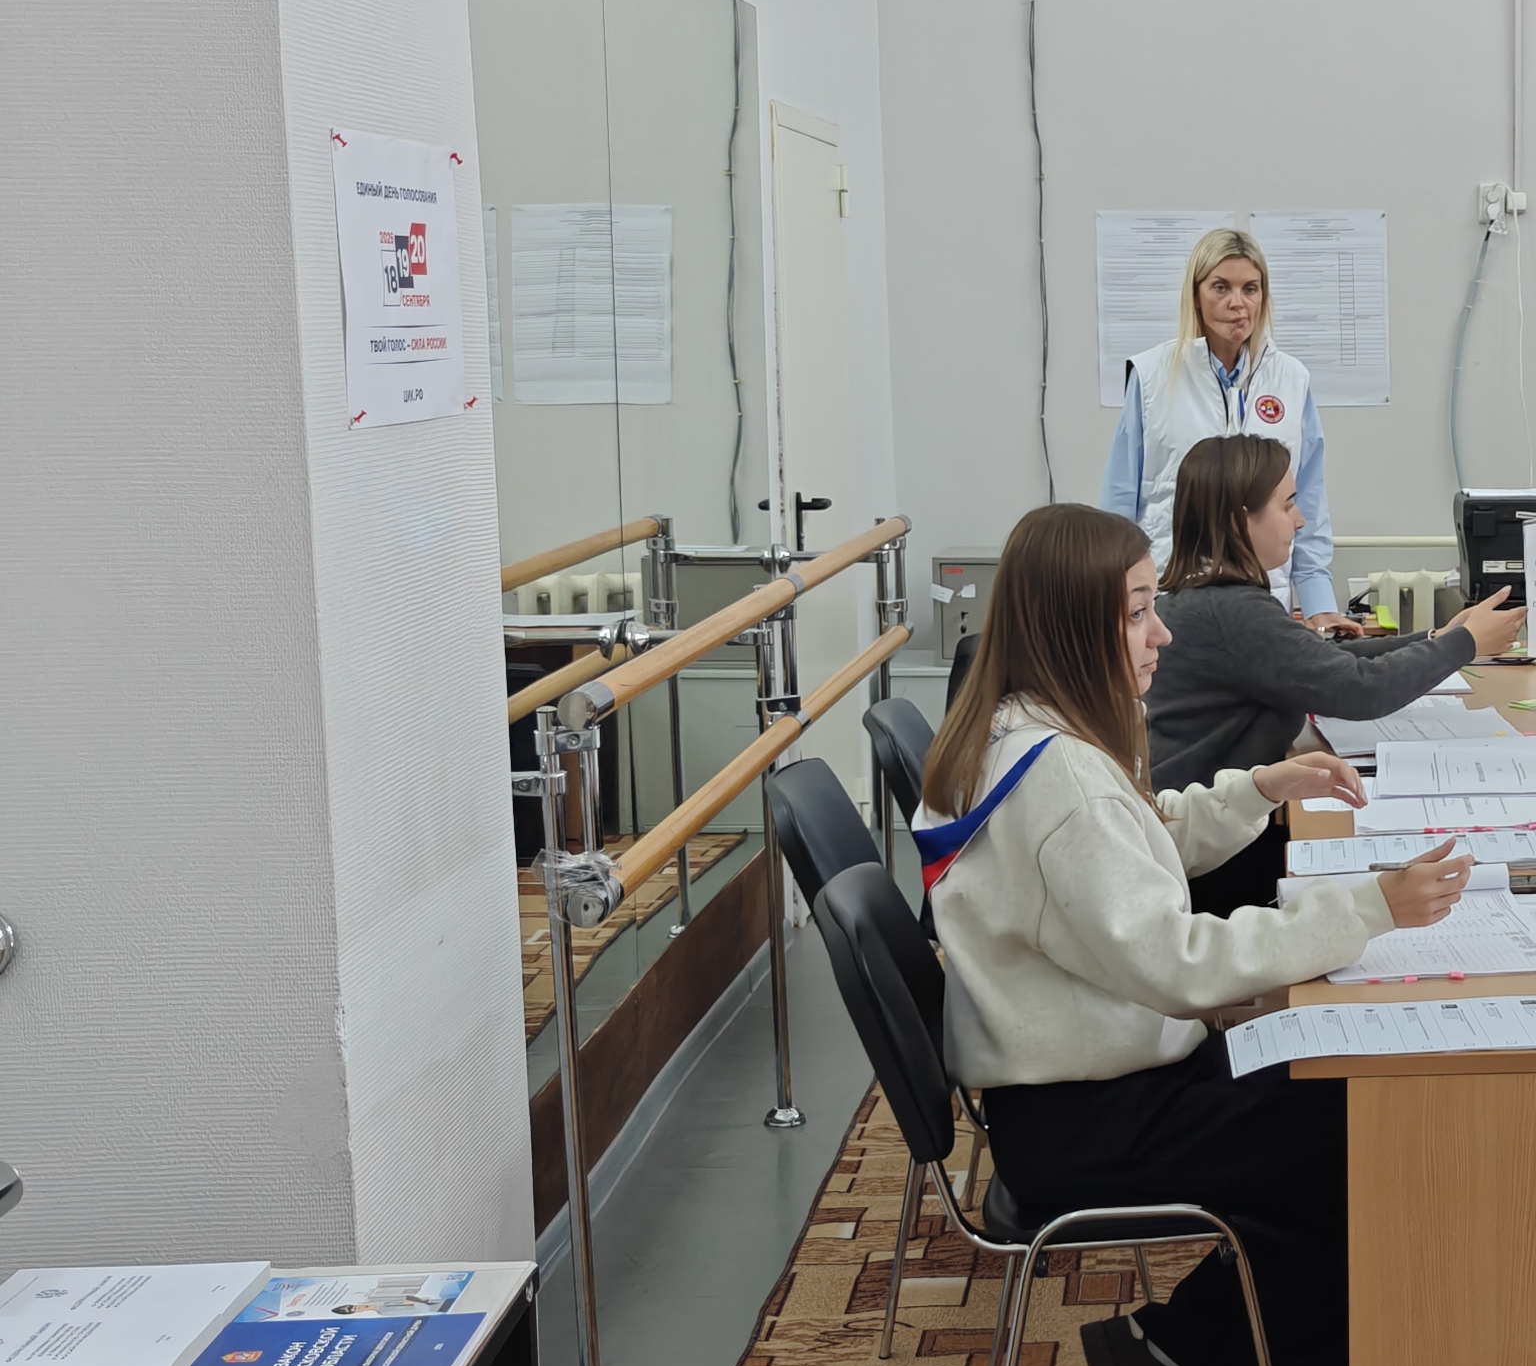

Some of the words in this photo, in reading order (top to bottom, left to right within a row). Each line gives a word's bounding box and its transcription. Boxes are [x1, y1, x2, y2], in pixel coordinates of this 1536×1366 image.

[384, 185, 399, 200] ДЕНЬ
[411, 235, 425, 263] 20
[397, 248, 409, 277] 19
[385, 265, 398, 294] 18
[403, 295, 430, 307] СЕНТЯБРЯ
[370, 336, 387, 352] ТВОЙ
